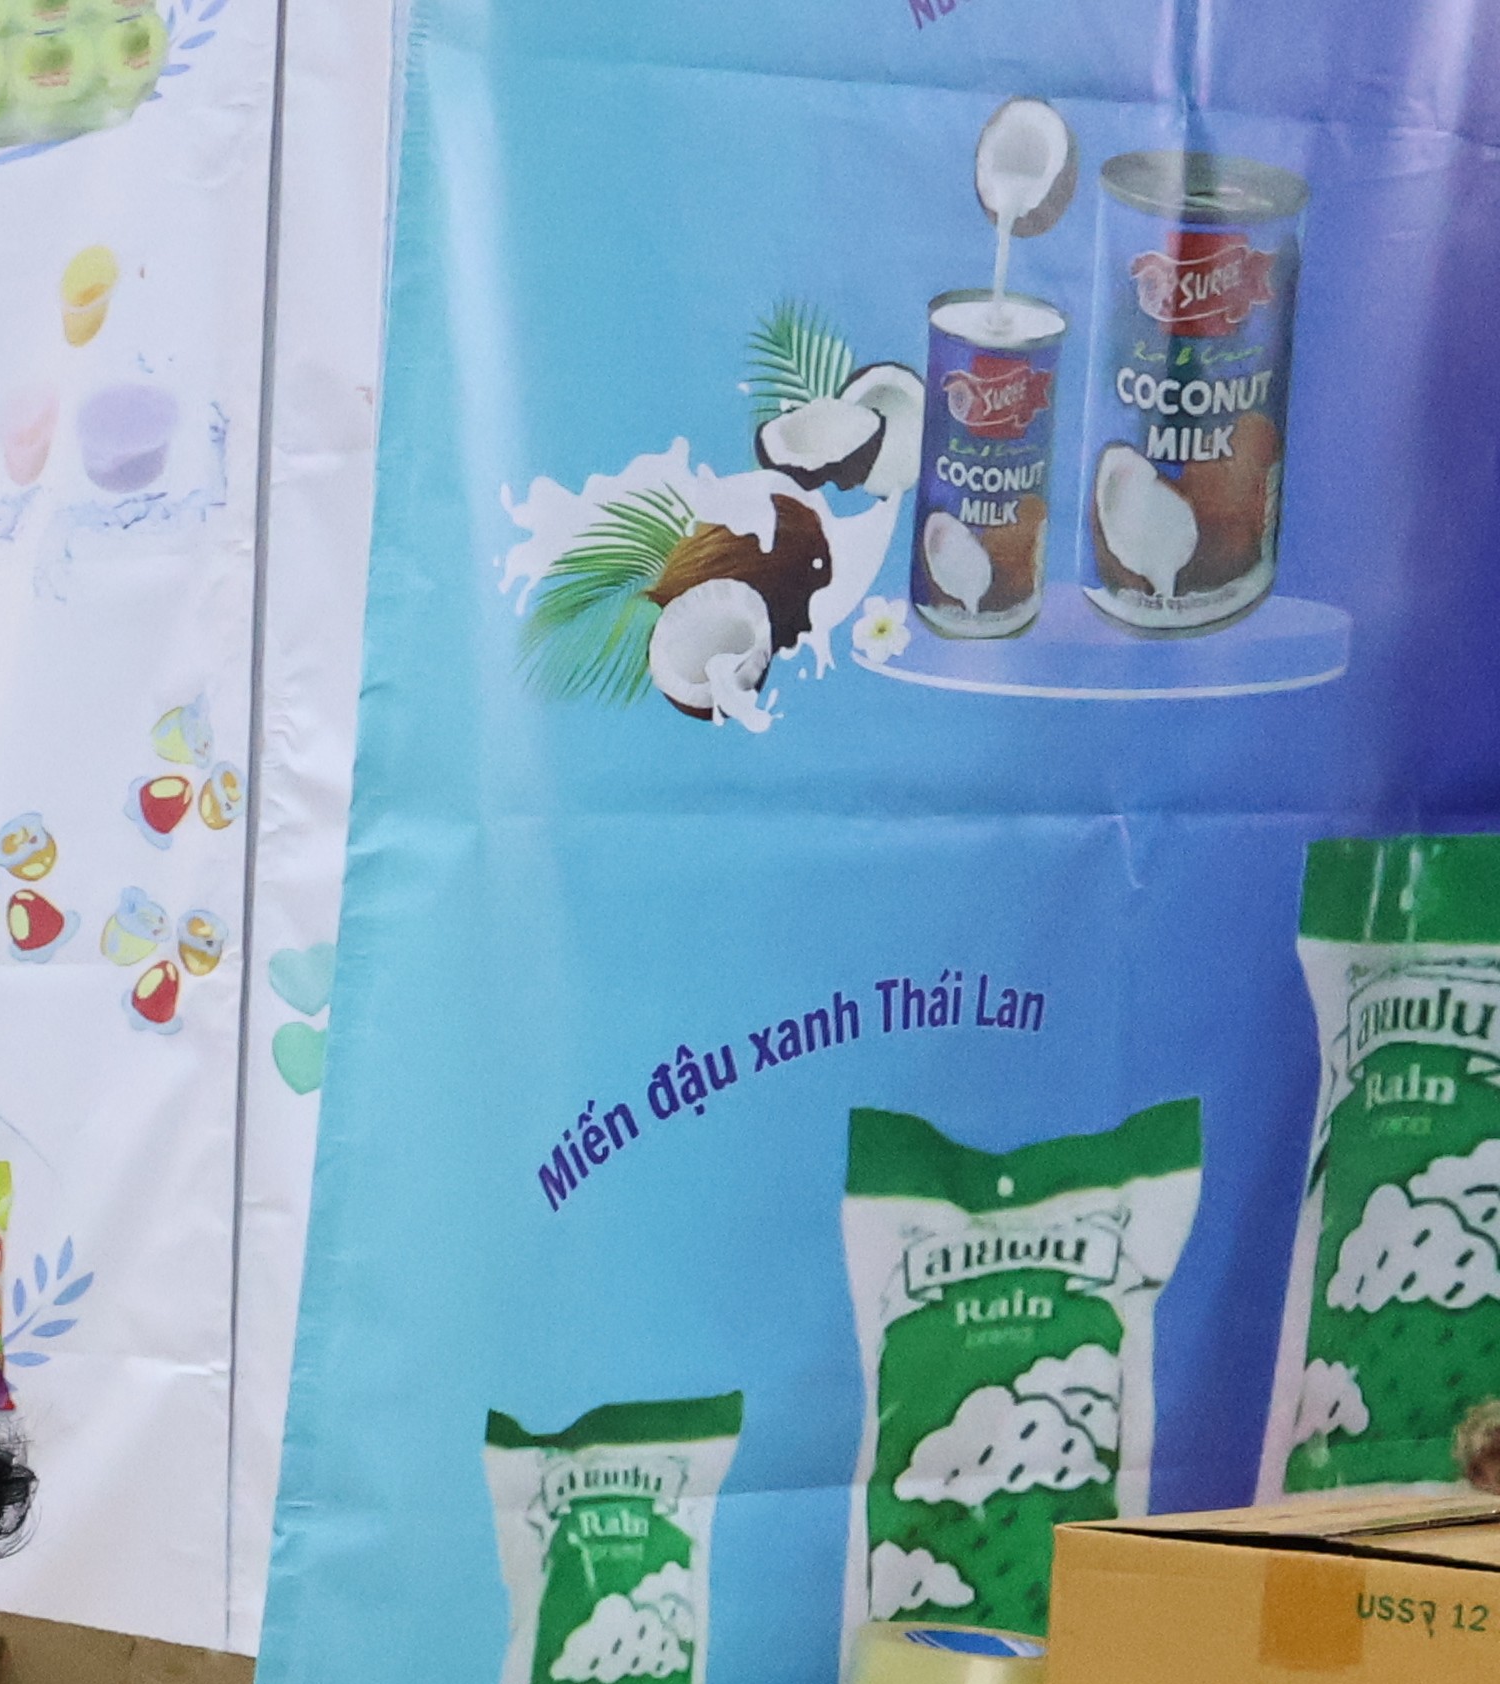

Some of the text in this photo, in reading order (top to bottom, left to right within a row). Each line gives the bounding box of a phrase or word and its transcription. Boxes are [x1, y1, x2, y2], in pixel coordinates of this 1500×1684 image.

[1115, 367, 1274, 417] COCONUT
[1146, 424, 1235, 462] MILK
[935, 455, 1047, 494] COCONUT
[959, 497, 1020, 527] MILK
[536, 968, 1046, 1212] Miến đậu xanh Thái Lan
[1364, 1063, 1457, 1112] Rain
[955, 1288, 1053, 1326] Rain
[578, 1509, 650, 1538] Rain
[1452, 1603, 1491, 1633] 12
